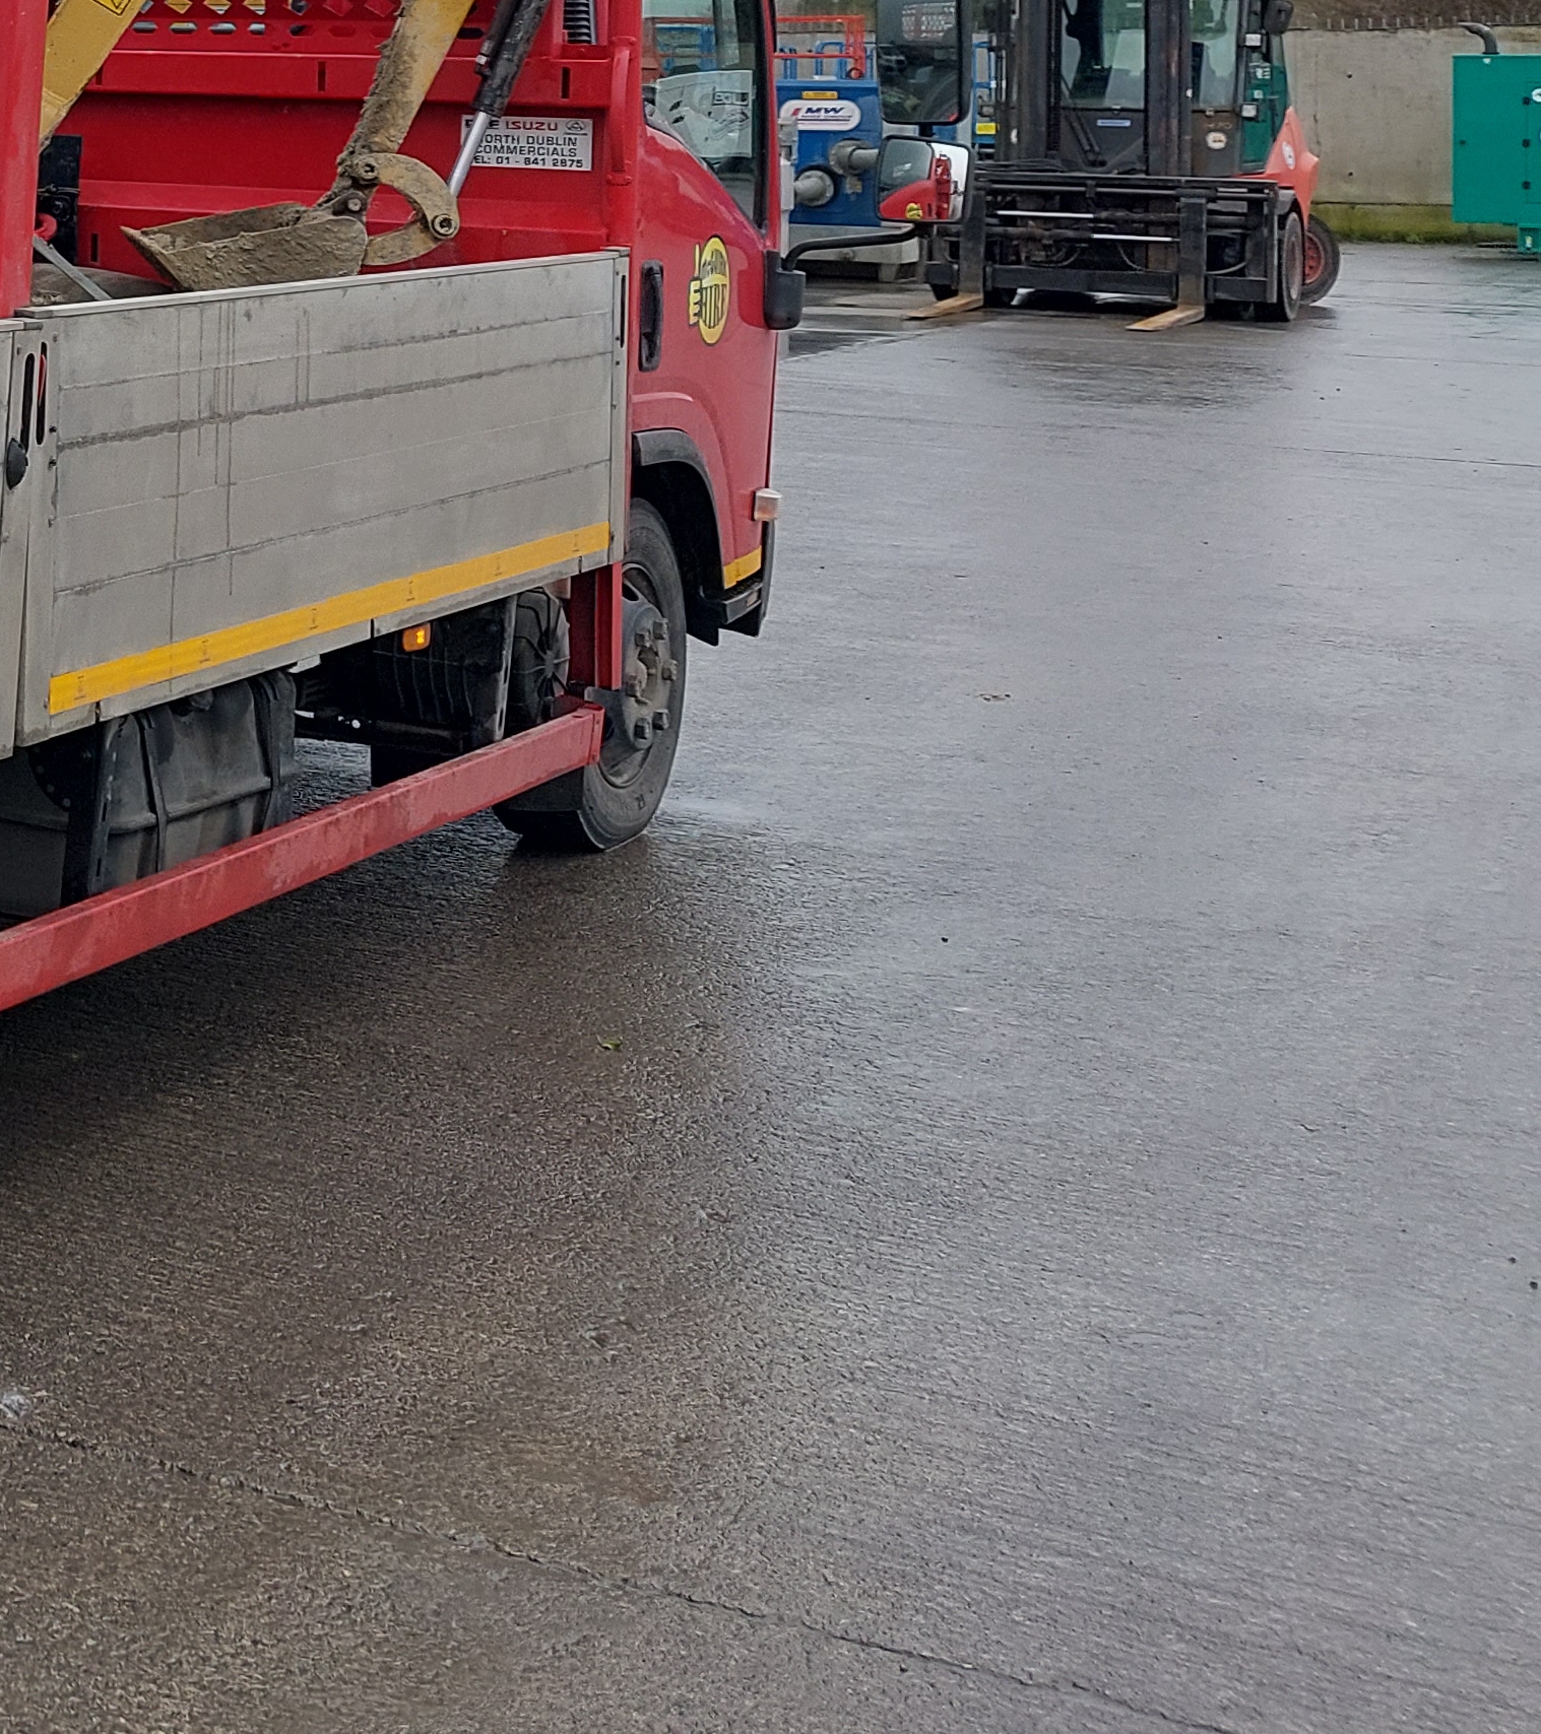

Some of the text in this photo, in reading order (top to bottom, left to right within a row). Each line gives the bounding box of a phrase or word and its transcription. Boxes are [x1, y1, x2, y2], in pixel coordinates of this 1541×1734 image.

[506, 120, 558, 131] ISUZU
[526, 135, 577, 147] DUBLIN
[476, 144, 577, 157] COMMERCIALS
[474, 155, 491, 164] EL:
[496, 155, 510, 165] 01
